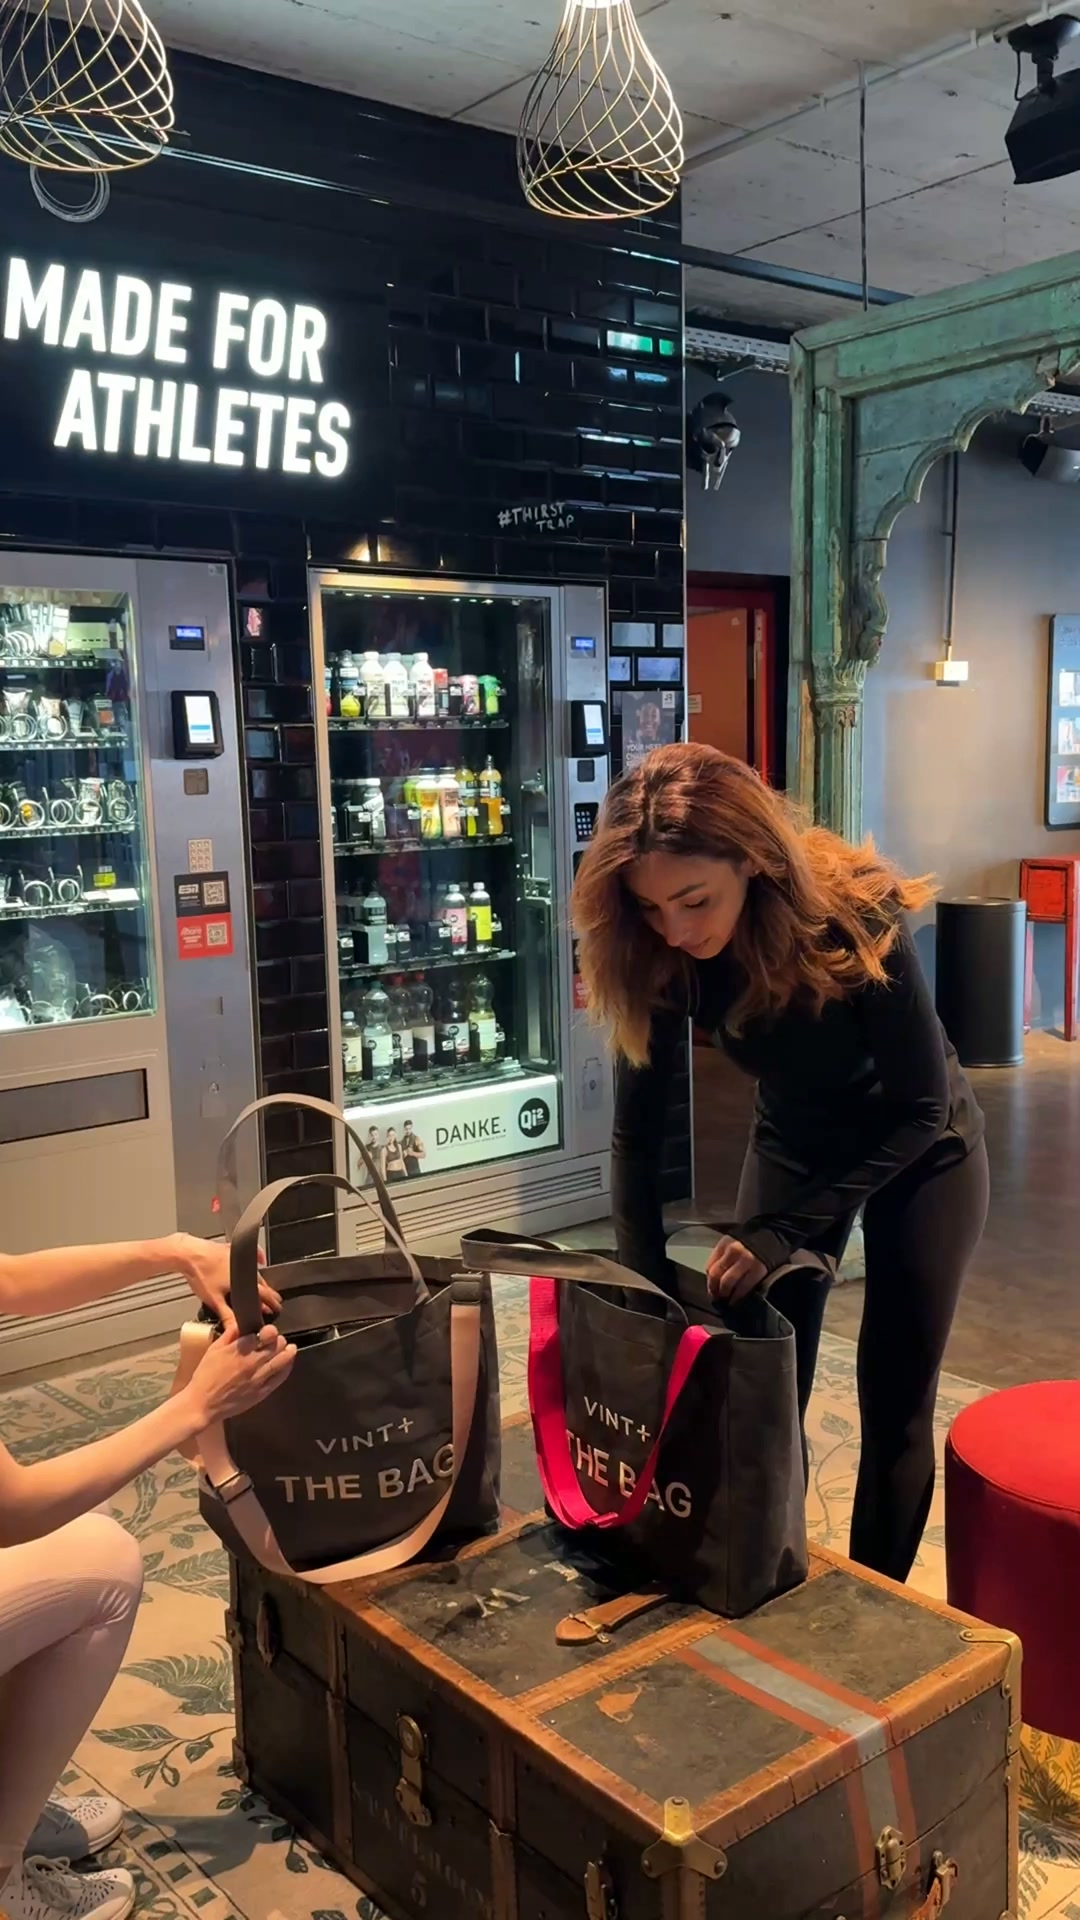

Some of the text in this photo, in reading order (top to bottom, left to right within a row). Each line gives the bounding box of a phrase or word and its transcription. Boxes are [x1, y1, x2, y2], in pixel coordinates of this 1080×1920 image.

[3, 257, 328, 384] MADE FOR
[53, 368, 353, 479] ATHLETES
[497, 501, 565, 529] #THIRST
[535, 514, 575, 533] TRAP
[436, 1116, 507, 1146] DANKE.
[315, 1416, 414, 1454] VINT+
[583, 1395, 651, 1443] VINT+
[275, 1442, 455, 1504] THE BAG
[619, 1460, 692, 1519] BAG
